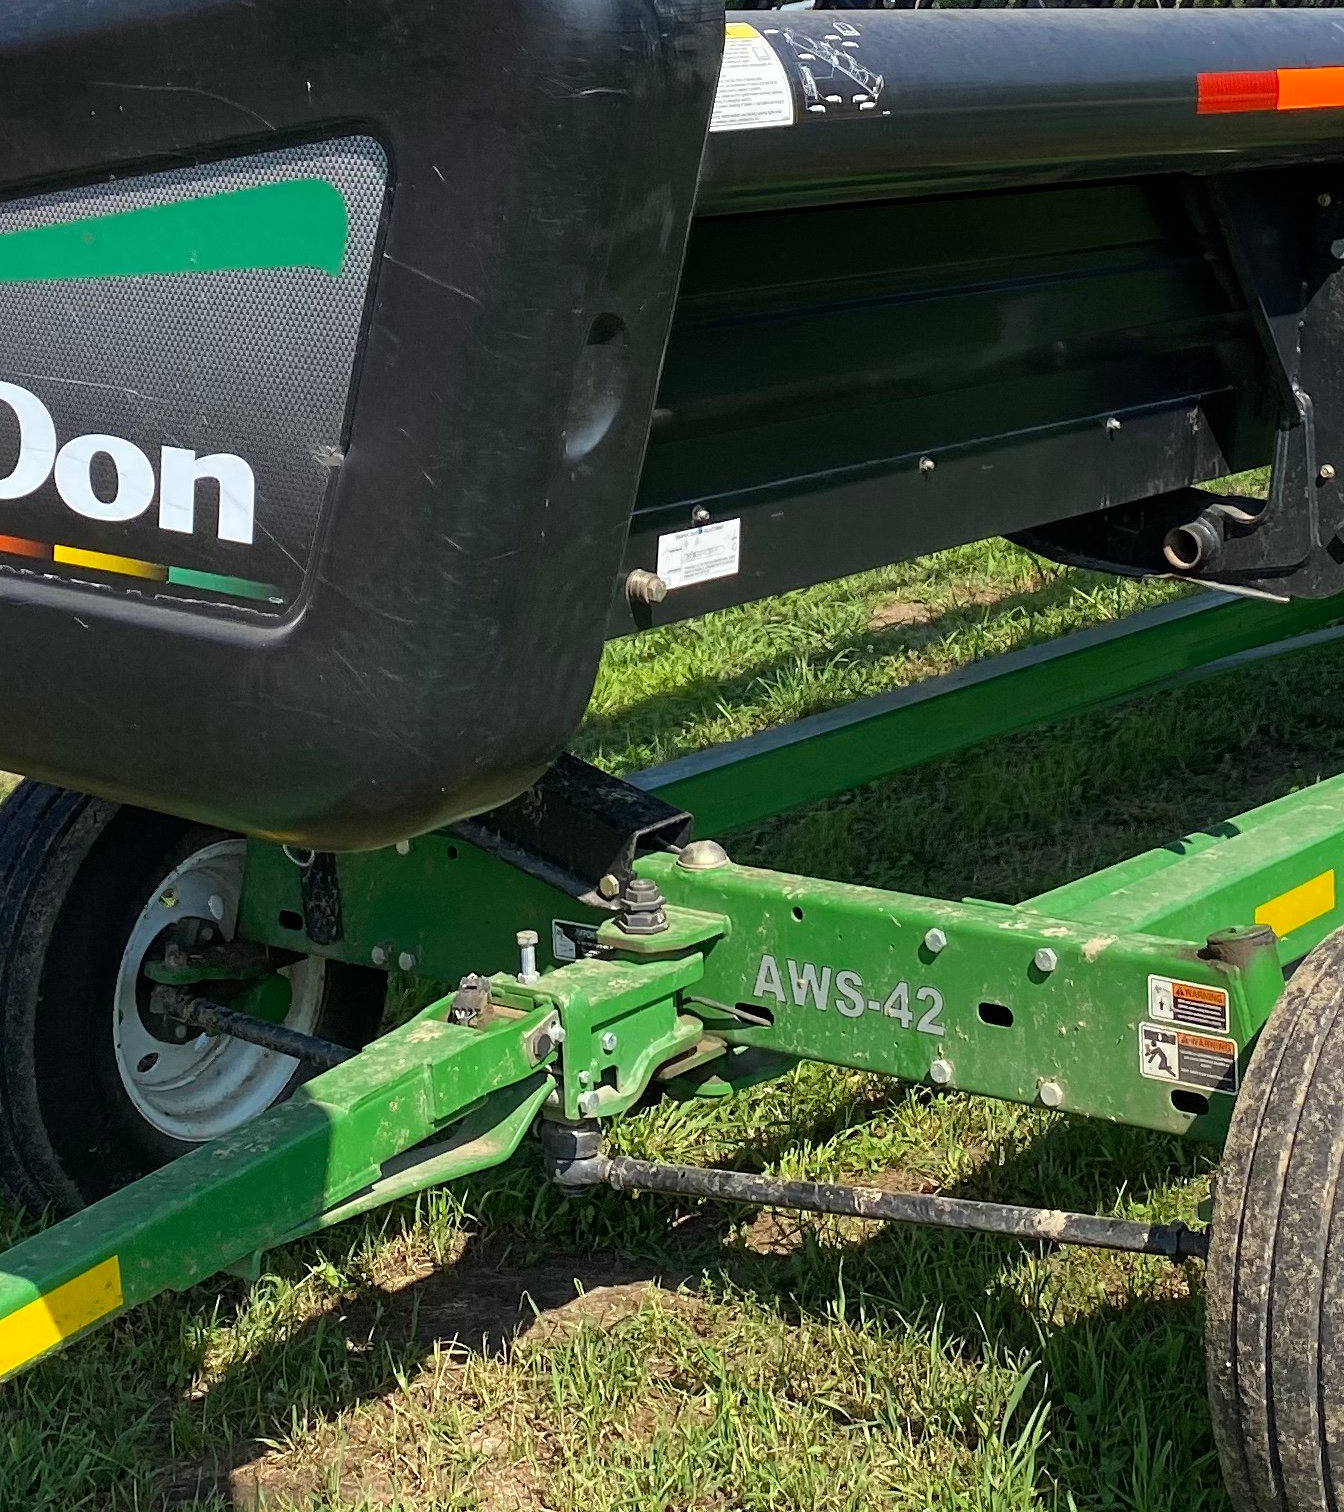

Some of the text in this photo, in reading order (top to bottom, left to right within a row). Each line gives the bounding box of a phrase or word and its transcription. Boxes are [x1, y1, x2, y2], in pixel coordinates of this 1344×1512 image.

[753, 954, 947, 1037] AWS-42
[1185, 989, 1223, 1004] WARNING
[1191, 1039, 1232, 1052] WARNING
